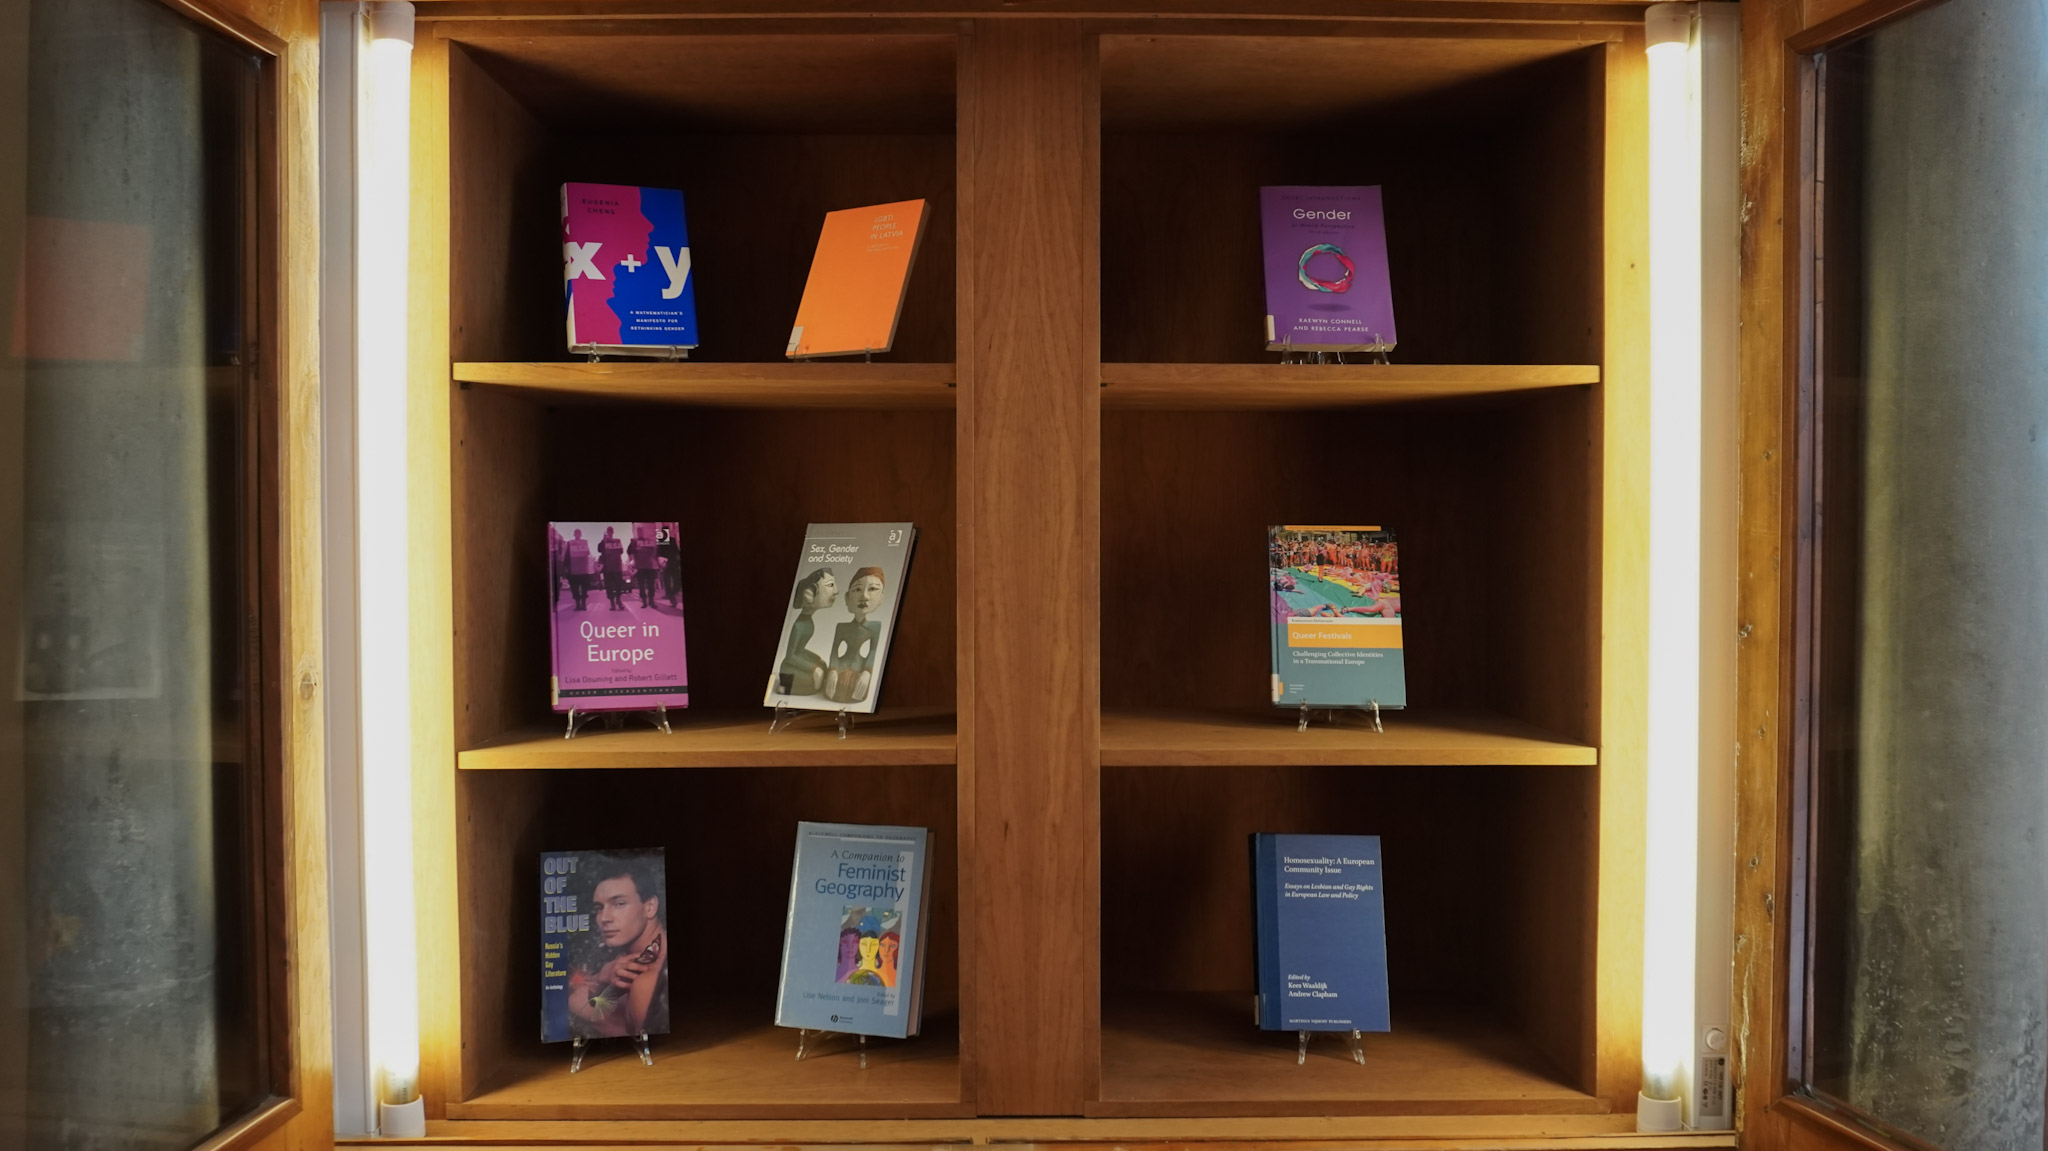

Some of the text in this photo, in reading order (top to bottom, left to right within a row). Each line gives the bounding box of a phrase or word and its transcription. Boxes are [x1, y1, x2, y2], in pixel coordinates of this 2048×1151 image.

[1293, 208, 1352, 220] Gender
[880, 230, 903, 239] LATVIA
[654, 246, 691, 299] y
[810, 544, 859, 553] Sex, Gender
[808, 554, 853, 564] and Society
[580, 620, 659, 641] Queer in
[1292, 632, 1352, 640] Queer Festivals
[587, 644, 654, 665] Europe
[582, 676, 612, 684] Downing
[831, 850, 904, 864] A Companion to
[1284, 857, 1336, 866] Homosexuality:
[1343, 858, 1375, 867] European
[544, 857, 579, 875] OUT
[838, 862, 906, 882] Feminist
[1284, 866, 1324, 875] Community
[544, 876, 568, 894] OF
[815, 878, 904, 901] Geography
[544, 896, 577, 914] THE
[545, 914, 590, 934] BLUE
[545, 961, 554, 969] Gay
[818, 993, 840, 1001] Nelson
[872, 997, 895, 1006] Seager
[1312, 991, 1337, 999] Clapham
